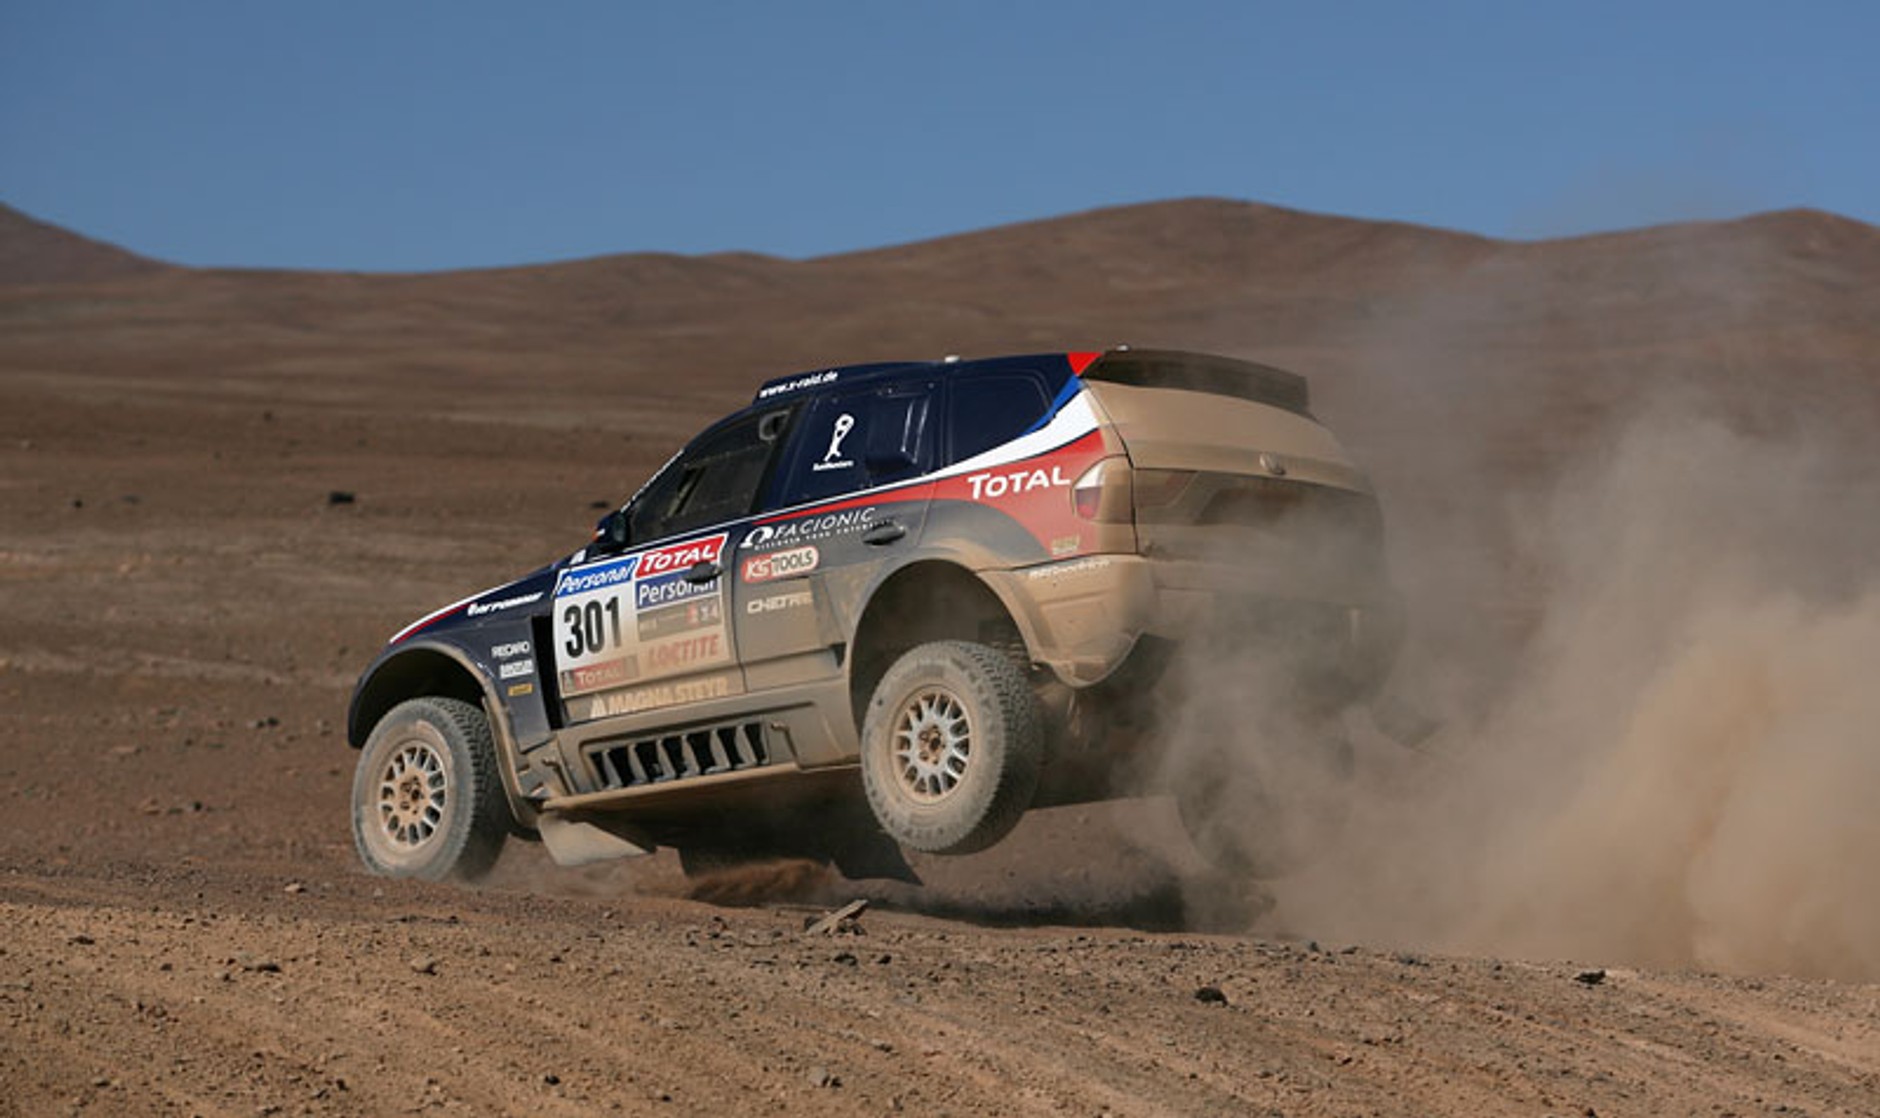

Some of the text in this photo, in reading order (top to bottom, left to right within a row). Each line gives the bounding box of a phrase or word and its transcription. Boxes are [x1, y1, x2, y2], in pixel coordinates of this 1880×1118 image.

[967, 465, 1071, 500] TOTAL
[773, 507, 876, 539] FACIONIC
[644, 544, 715, 572] TOTAL
[557, 559, 637, 595] Personal
[563, 596, 622, 659] 301
